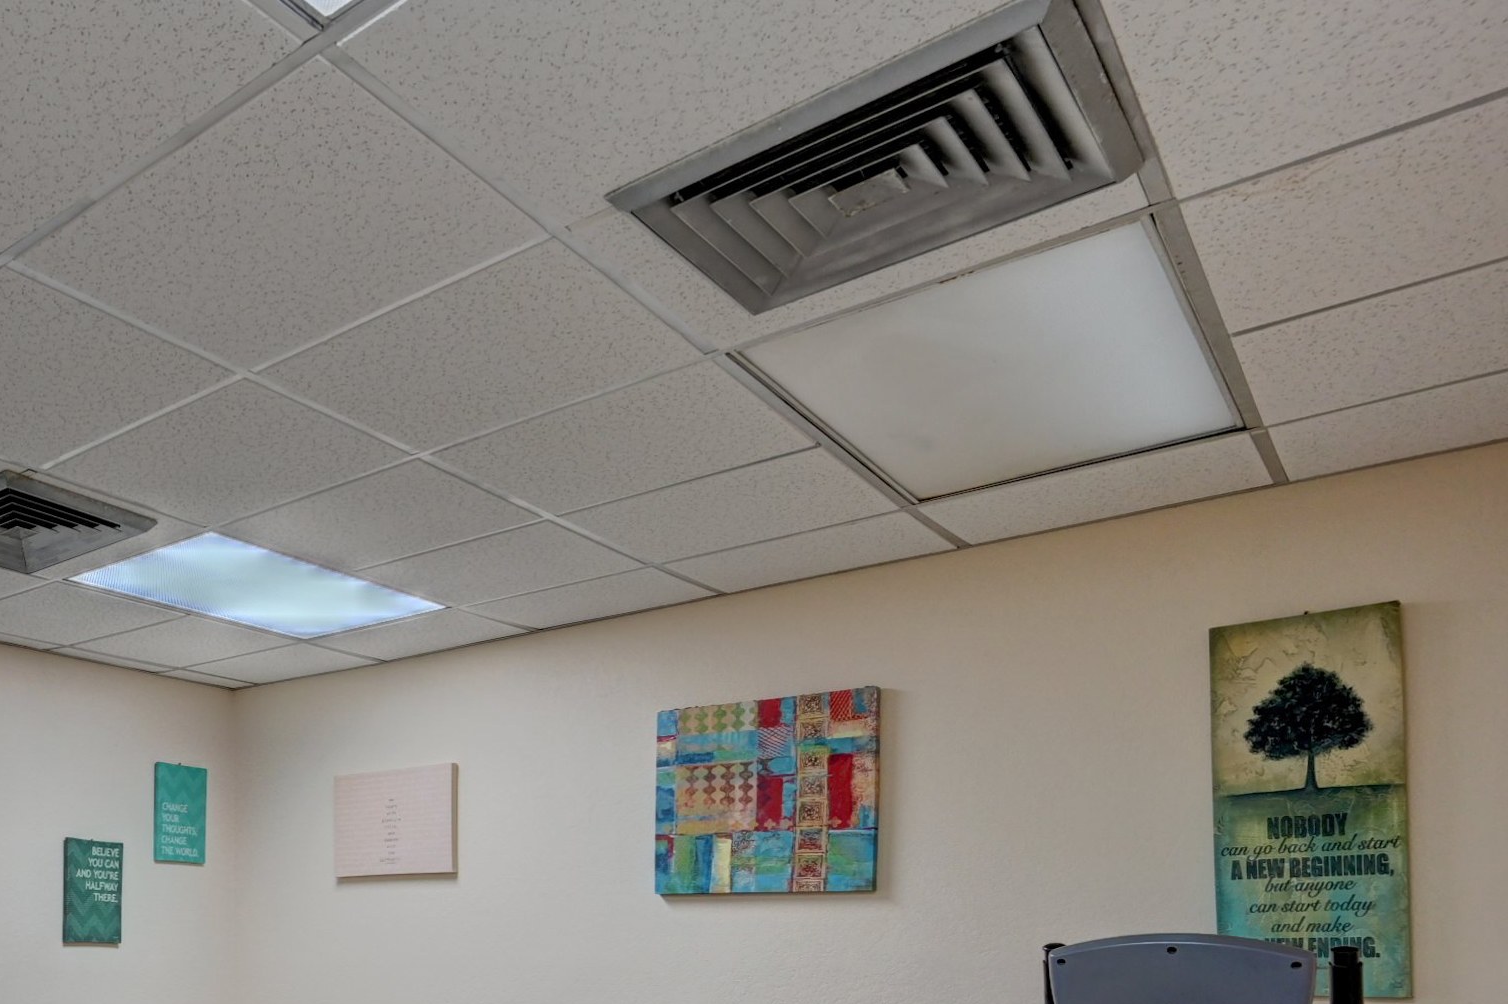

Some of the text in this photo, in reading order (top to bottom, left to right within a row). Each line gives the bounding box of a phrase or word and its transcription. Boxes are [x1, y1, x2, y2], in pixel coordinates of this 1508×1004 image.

[162, 802, 189, 814] CHANGE
[162, 813, 180, 823] YOUR
[1267, 812, 1348, 840] NOBODY
[161, 834, 188, 845] CHANGE
[92, 846, 120, 858] BELIEVE
[161, 845, 174, 856] THE
[1220, 833, 1403, 861] can go back and start
[88, 857, 120, 869] YOU CAN
[1231, 852, 1394, 880] A NEW BEGINNING,
[76, 868, 119, 880] AND YOU'RE
[85, 881, 119, 892] HALFWAY
[1264, 877, 1356, 898] but anyone
[1249, 894, 1376, 918] can start today
[1271, 916, 1355, 933] and make
